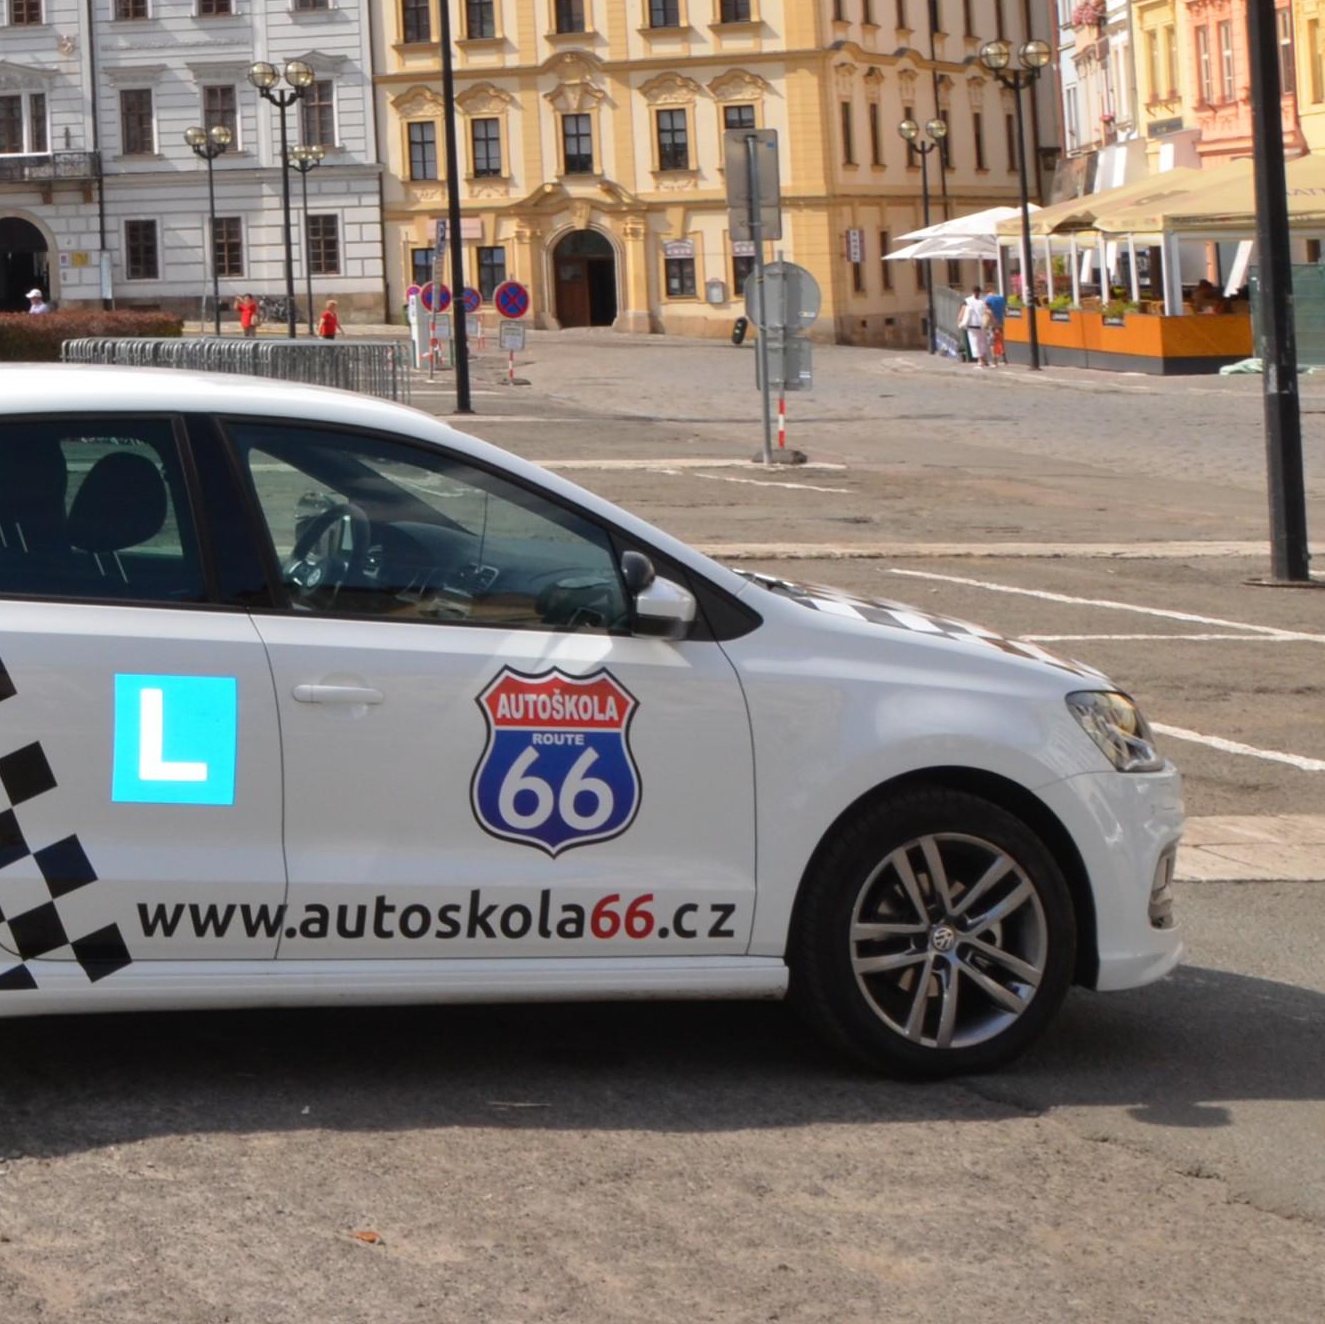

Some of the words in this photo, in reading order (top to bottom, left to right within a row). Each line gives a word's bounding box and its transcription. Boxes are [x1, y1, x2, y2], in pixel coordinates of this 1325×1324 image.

[496, 687, 619, 722] AUTOŠKOLA
[138, 688, 208, 781] L
[532, 732, 585, 747] ROUTE
[497, 746, 615, 831] 66
[137, 888, 735, 939] www.autoskola66.cz
